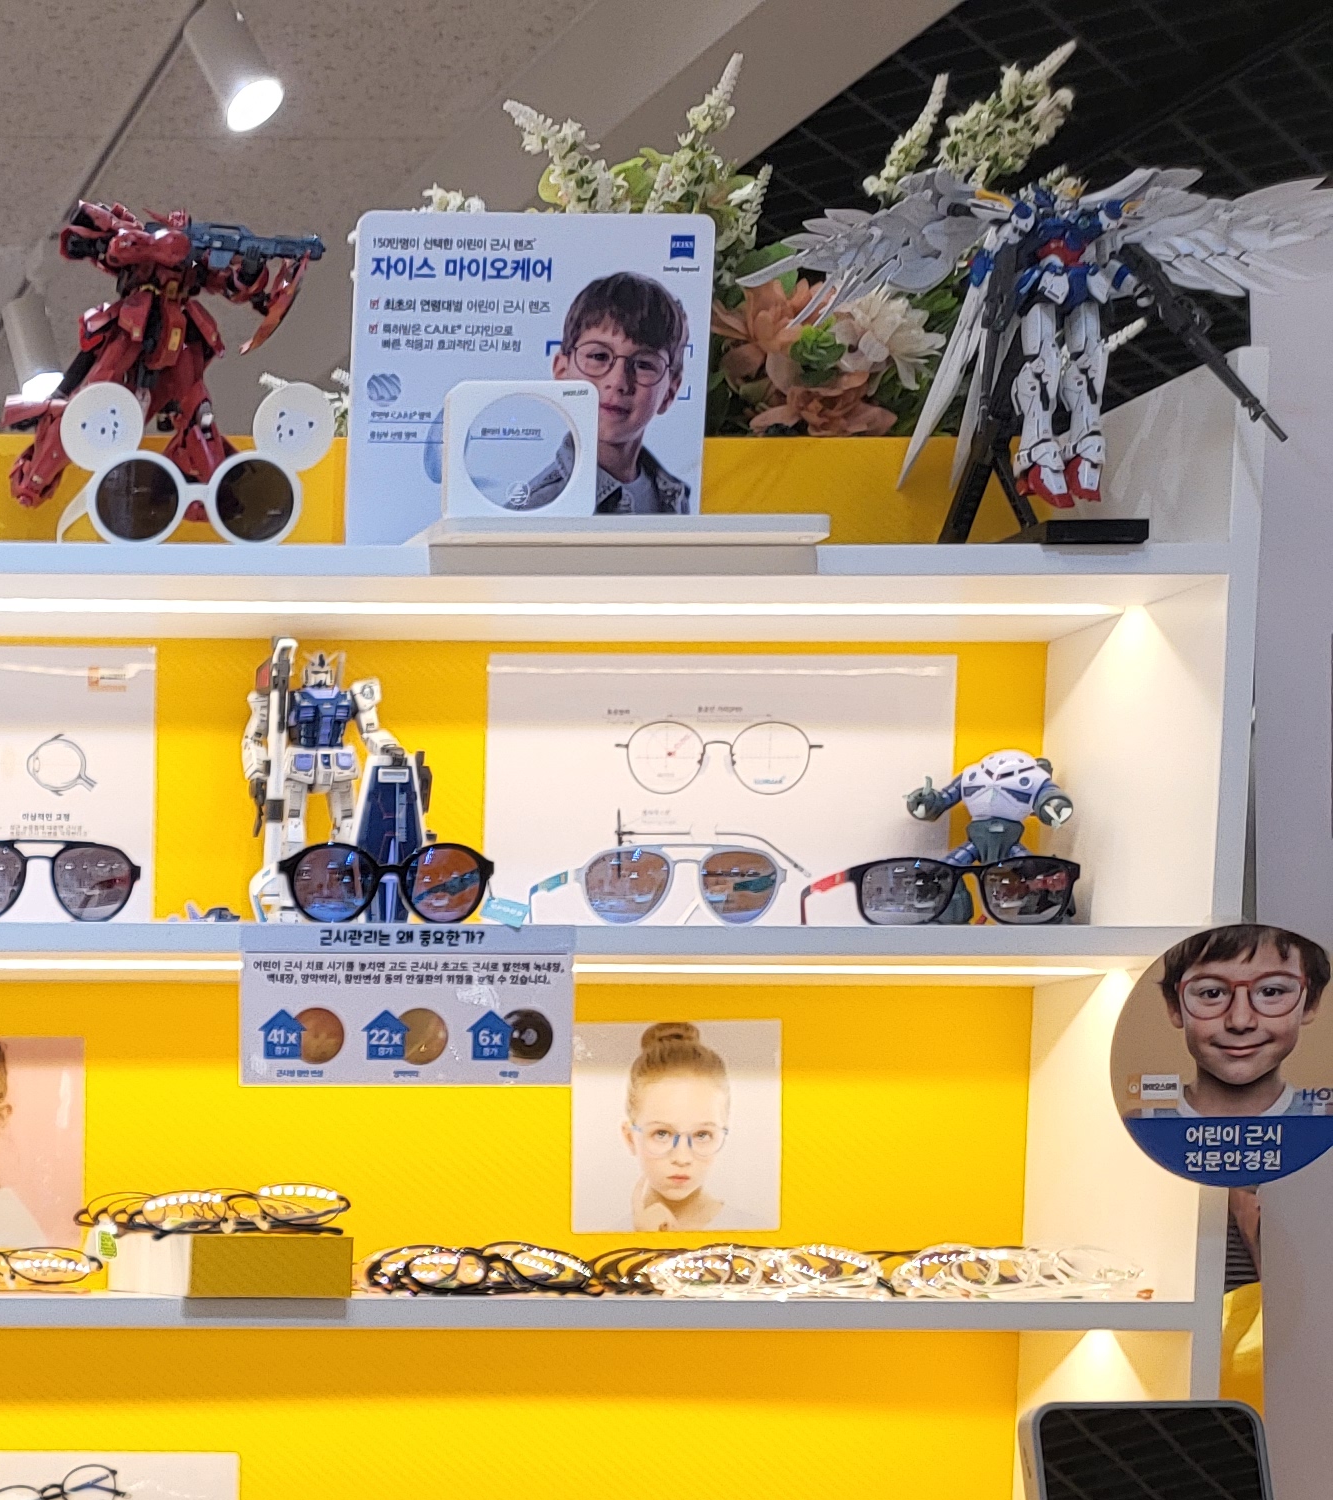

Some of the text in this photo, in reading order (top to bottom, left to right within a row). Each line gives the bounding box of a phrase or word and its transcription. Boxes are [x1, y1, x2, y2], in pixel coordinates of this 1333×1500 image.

[457, 237, 486, 251] 어린이
[490, 238, 510, 251] 근시
[371, 255, 553, 282] 자이스 마이오케어
[467, 299, 499, 313] 어린이
[503, 300, 524, 314] 근시
[529, 300, 551, 314] 렌즈
[479, 339, 498, 352] 근시
[319, 929, 485, 947] 근시관리는 왜 중요한가?
[253, 960, 280, 972] 어린이
[284, 960, 303, 972] 근시
[305, 960, 323, 972] 치료
[388, 961, 407, 972] 고도
[441, 961, 469, 973] 초고도
[497, 974, 506, 985] 수
[267, 1029, 297, 1045] 41x
[369, 1029, 402, 1045] 22x
[478, 1029, 502, 1046] 6x
[1186, 1124, 1282, 1146] 어린이 근시
[1185, 1150, 1281, 1171] 전문안경원
